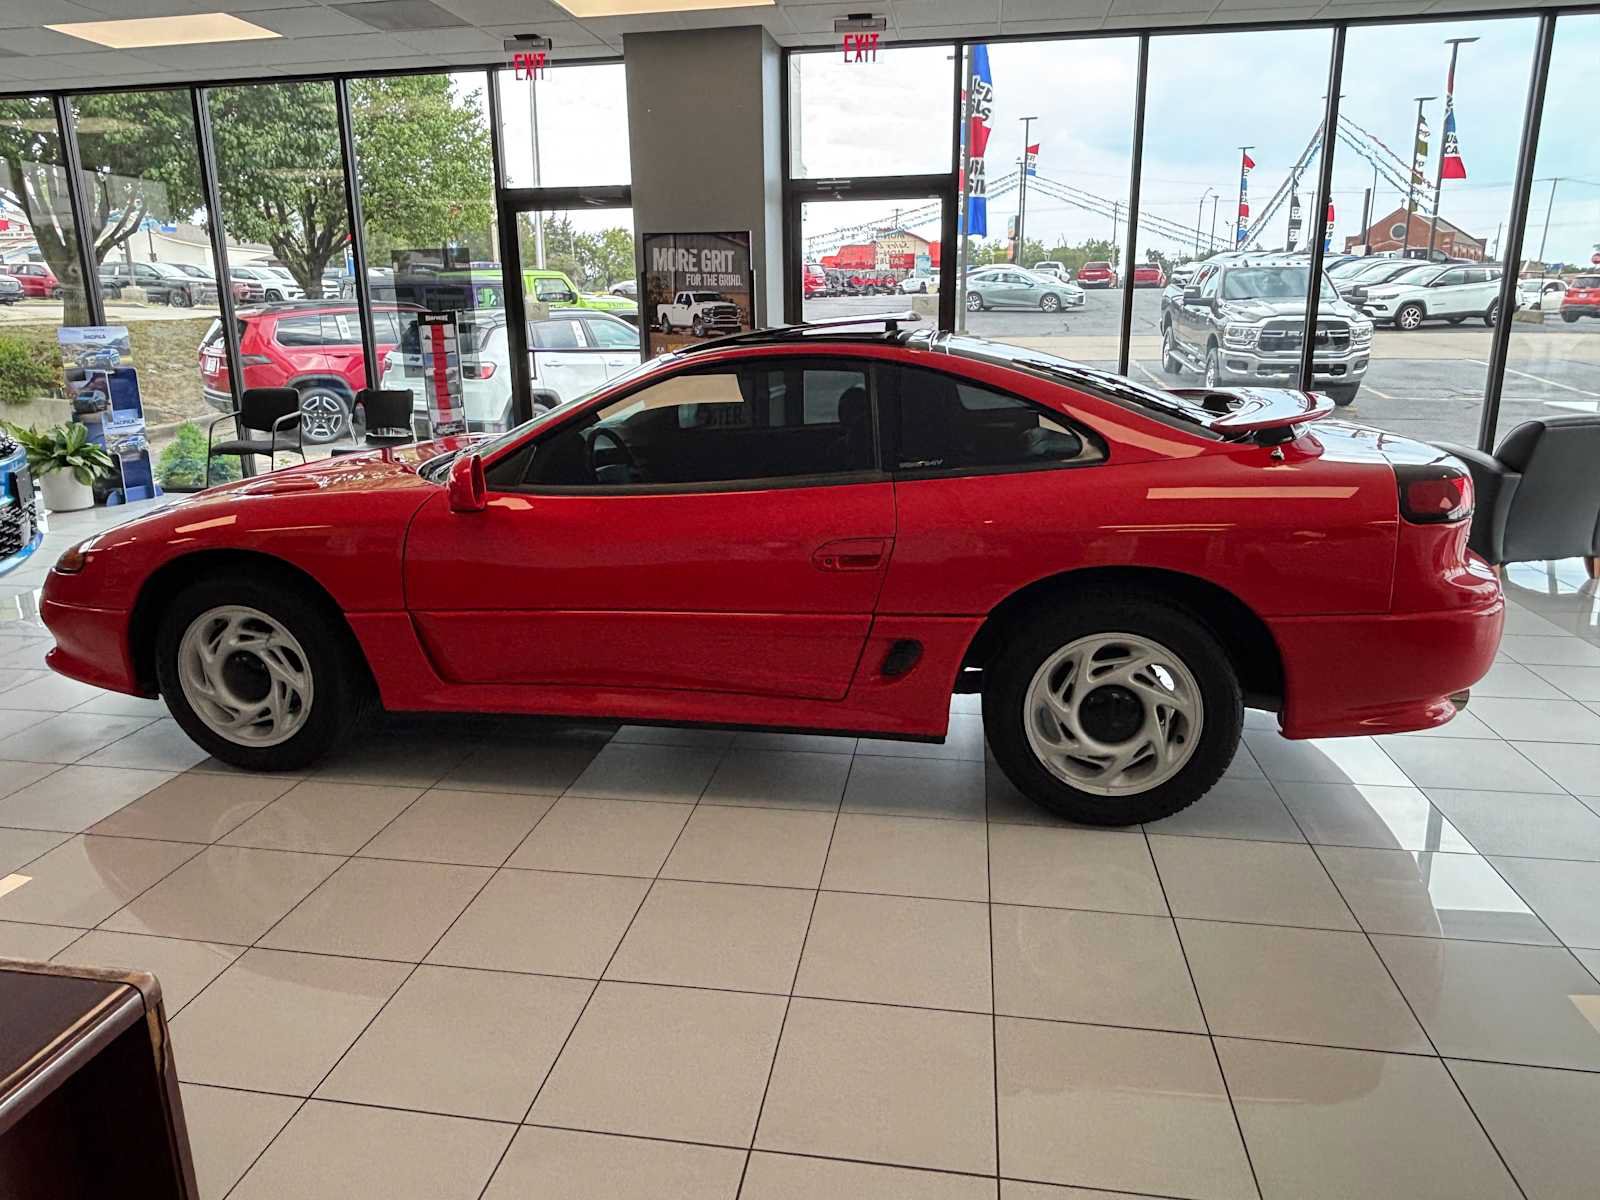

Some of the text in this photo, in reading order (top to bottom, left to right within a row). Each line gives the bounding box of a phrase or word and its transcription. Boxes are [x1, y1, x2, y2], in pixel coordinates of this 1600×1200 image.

[844, 33, 879, 63] EXIT
[513, 53, 545, 80] EXIT
[653, 247, 735, 273] MORE GRIT
[686, 274, 701, 287] FOR
[703, 274, 718, 287] THE
